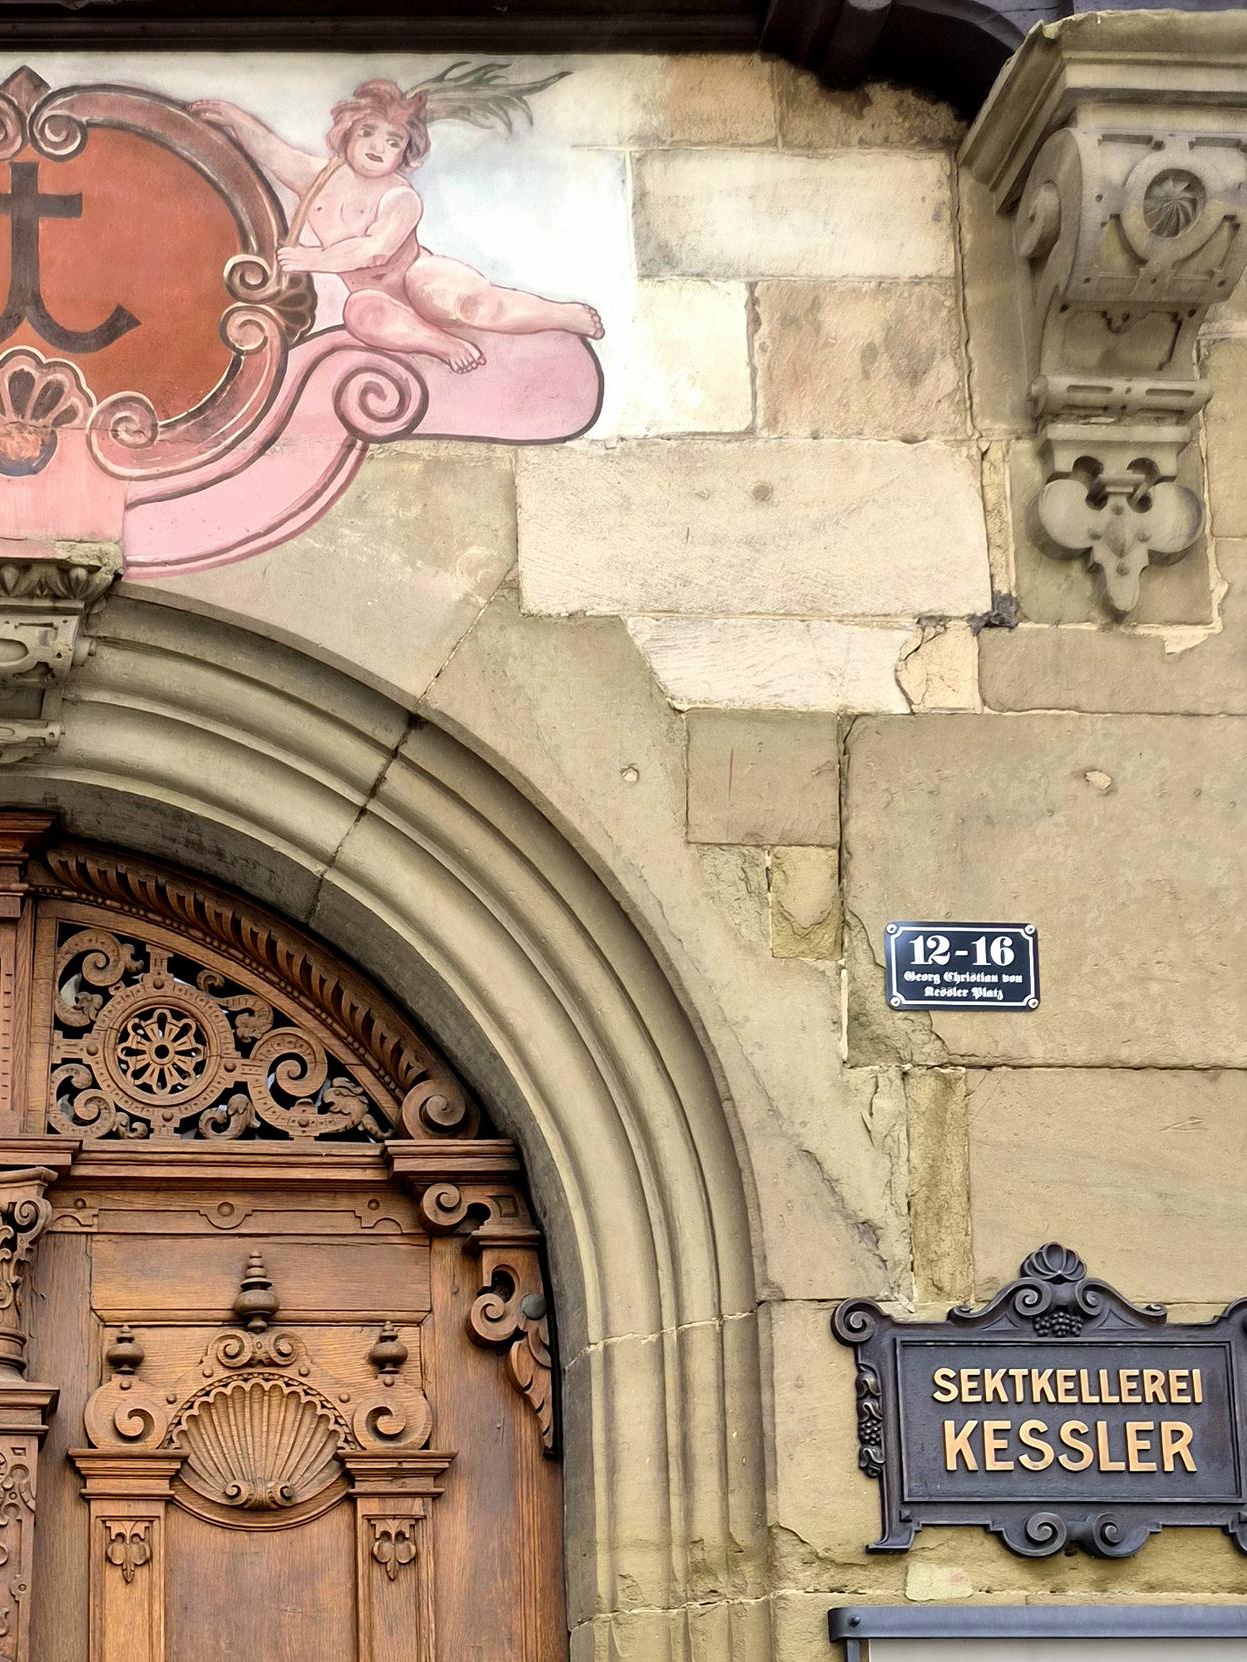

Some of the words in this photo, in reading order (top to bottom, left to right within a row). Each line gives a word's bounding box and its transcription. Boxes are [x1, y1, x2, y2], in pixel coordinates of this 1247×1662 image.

[909, 935, 1015, 966] 12-16
[904, 971, 941, 985] Georg
[944, 971, 998, 985] Christian
[1002, 974, 1023, 984] von
[924, 987, 969, 997] Kessler
[971, 987, 1004, 1000] Platz
[932, 1367, 1203, 1404] SEKTKELLEREI
[943, 1419, 1198, 1472] KESSLER
